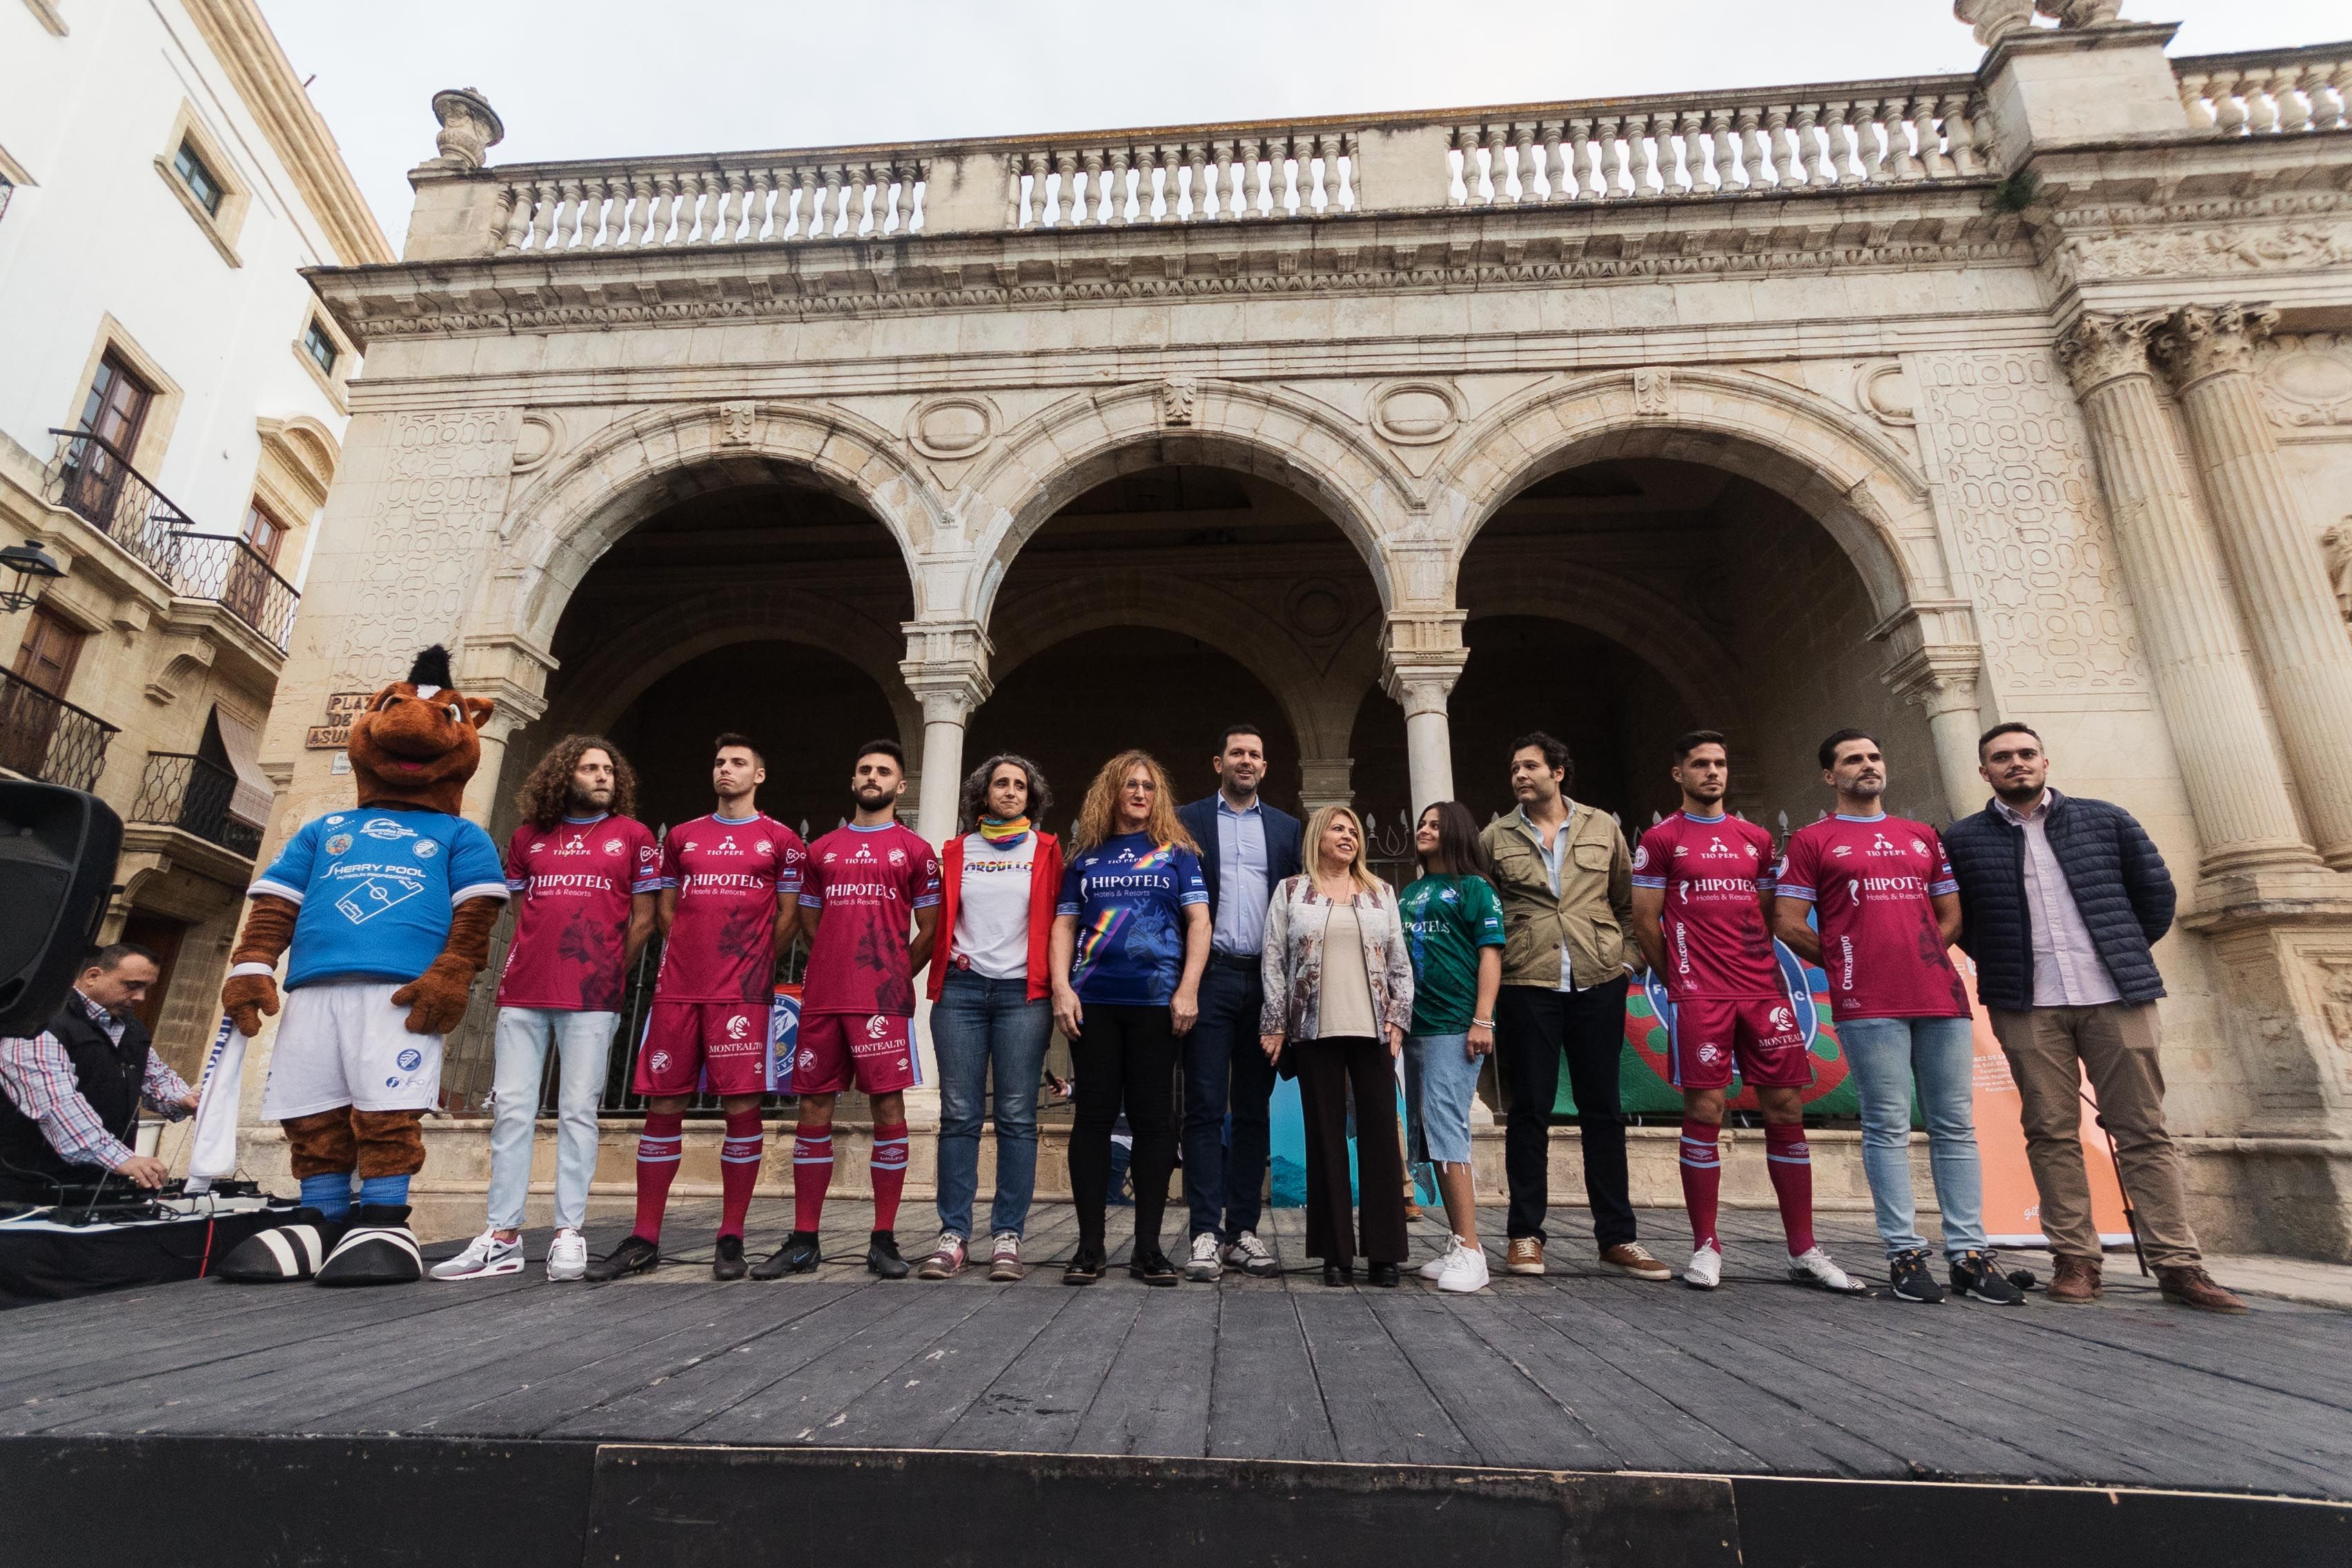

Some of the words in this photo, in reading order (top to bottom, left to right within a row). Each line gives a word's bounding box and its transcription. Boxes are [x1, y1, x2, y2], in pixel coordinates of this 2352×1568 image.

[331, 696, 371, 710] PLAZ
[320, 862, 383, 879] SHERRY
[385, 865, 427, 878] POOL
[538, 874, 613, 890] HIPOTELS
[693, 874, 764, 890] HIPOTELS
[1092, 875, 1170, 889] HIPOTELS
[1694, 879, 1758, 893] HIPOTE
[1864, 876, 1928, 893] HIPOTE
[564, 889, 591, 897] Resorts
[1402, 920, 1449, 934] IPOTELS
[1676, 922, 1690, 974] Cruzcampo
[1841, 936, 1854, 990] Cruzcampo
[851, 1039, 905, 1053] MONTEALTO
[1758, 1033, 1803, 1047] MONTEAL
[709, 1042, 763, 1053] MONTEALTO
